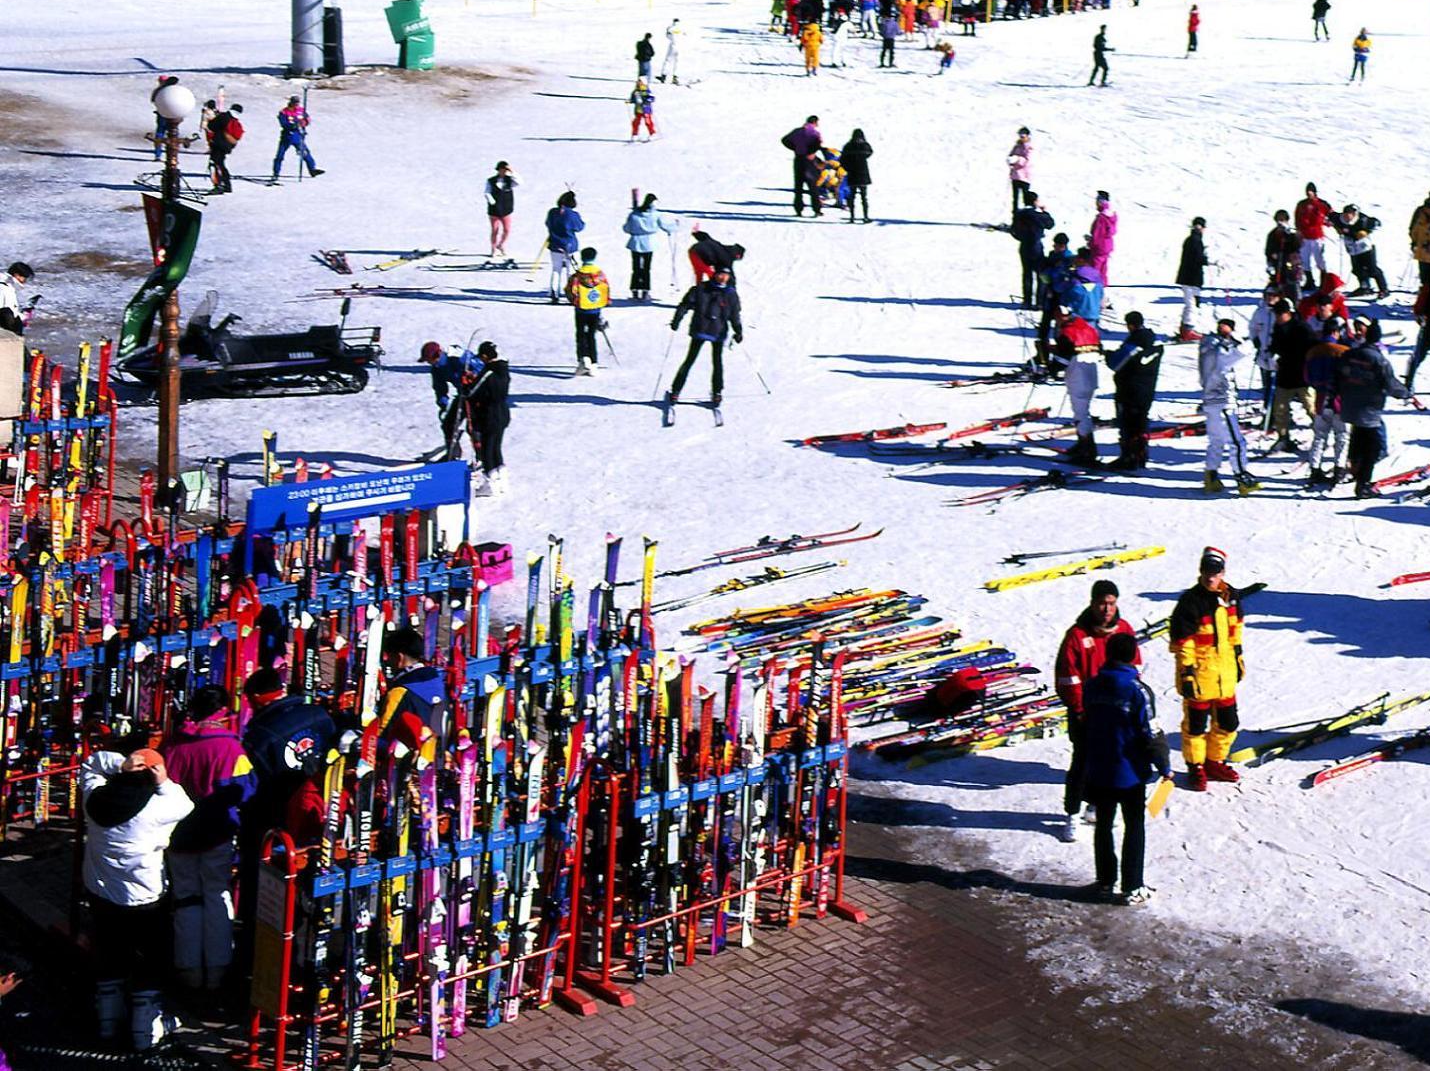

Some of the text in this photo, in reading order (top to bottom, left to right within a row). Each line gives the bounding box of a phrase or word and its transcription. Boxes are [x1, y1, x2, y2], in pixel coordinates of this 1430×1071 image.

[288, 351, 315, 360] YAMAHA
[305, 648, 314, 690] BLIZZARD
[330, 790, 340, 832] ATOMIC
[360, 811, 371, 855] ATOMIC
[353, 1011, 363, 1044] ATOMIC
